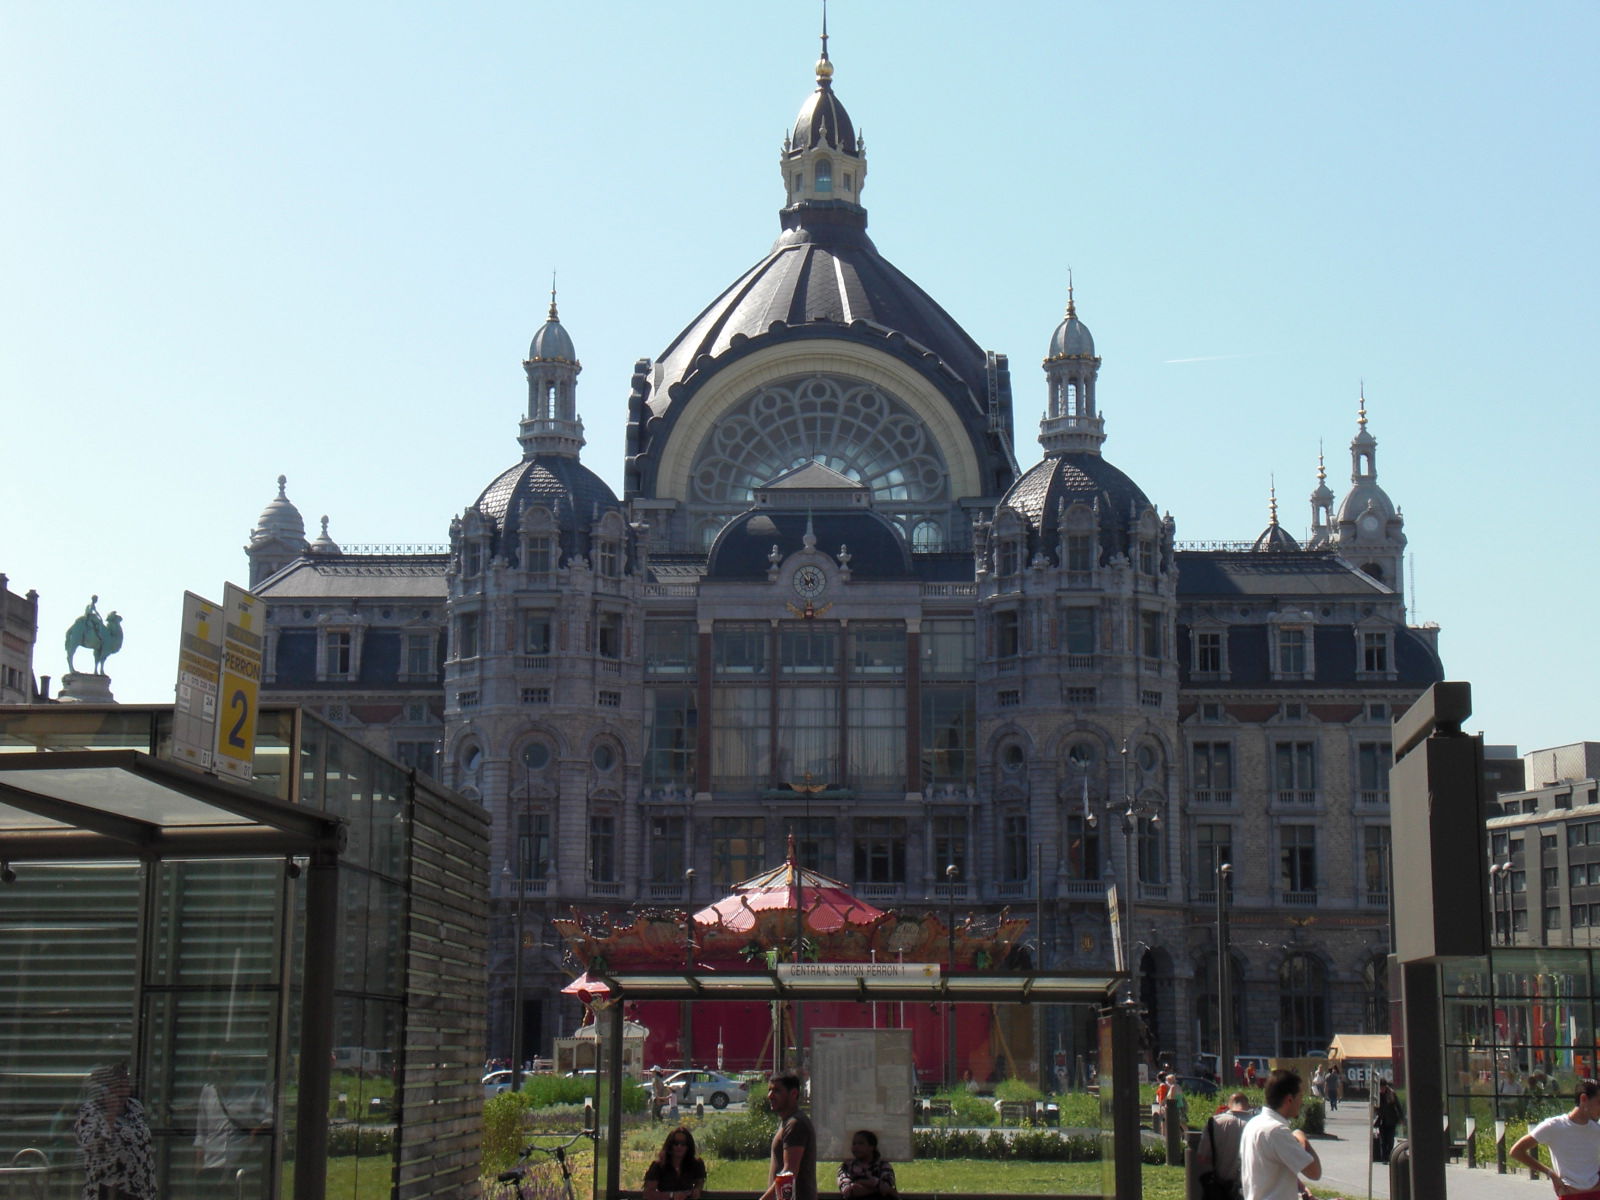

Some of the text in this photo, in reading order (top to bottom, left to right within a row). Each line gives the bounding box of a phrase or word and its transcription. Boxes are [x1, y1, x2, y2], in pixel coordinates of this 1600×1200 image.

[225, 651, 260, 681] PERRON
[228, 689, 248, 749] 2
[790, 965, 831, 977] CENTRAAL
[833, 965, 864, 977] STATION
[866, 965, 898, 976] PERRON
